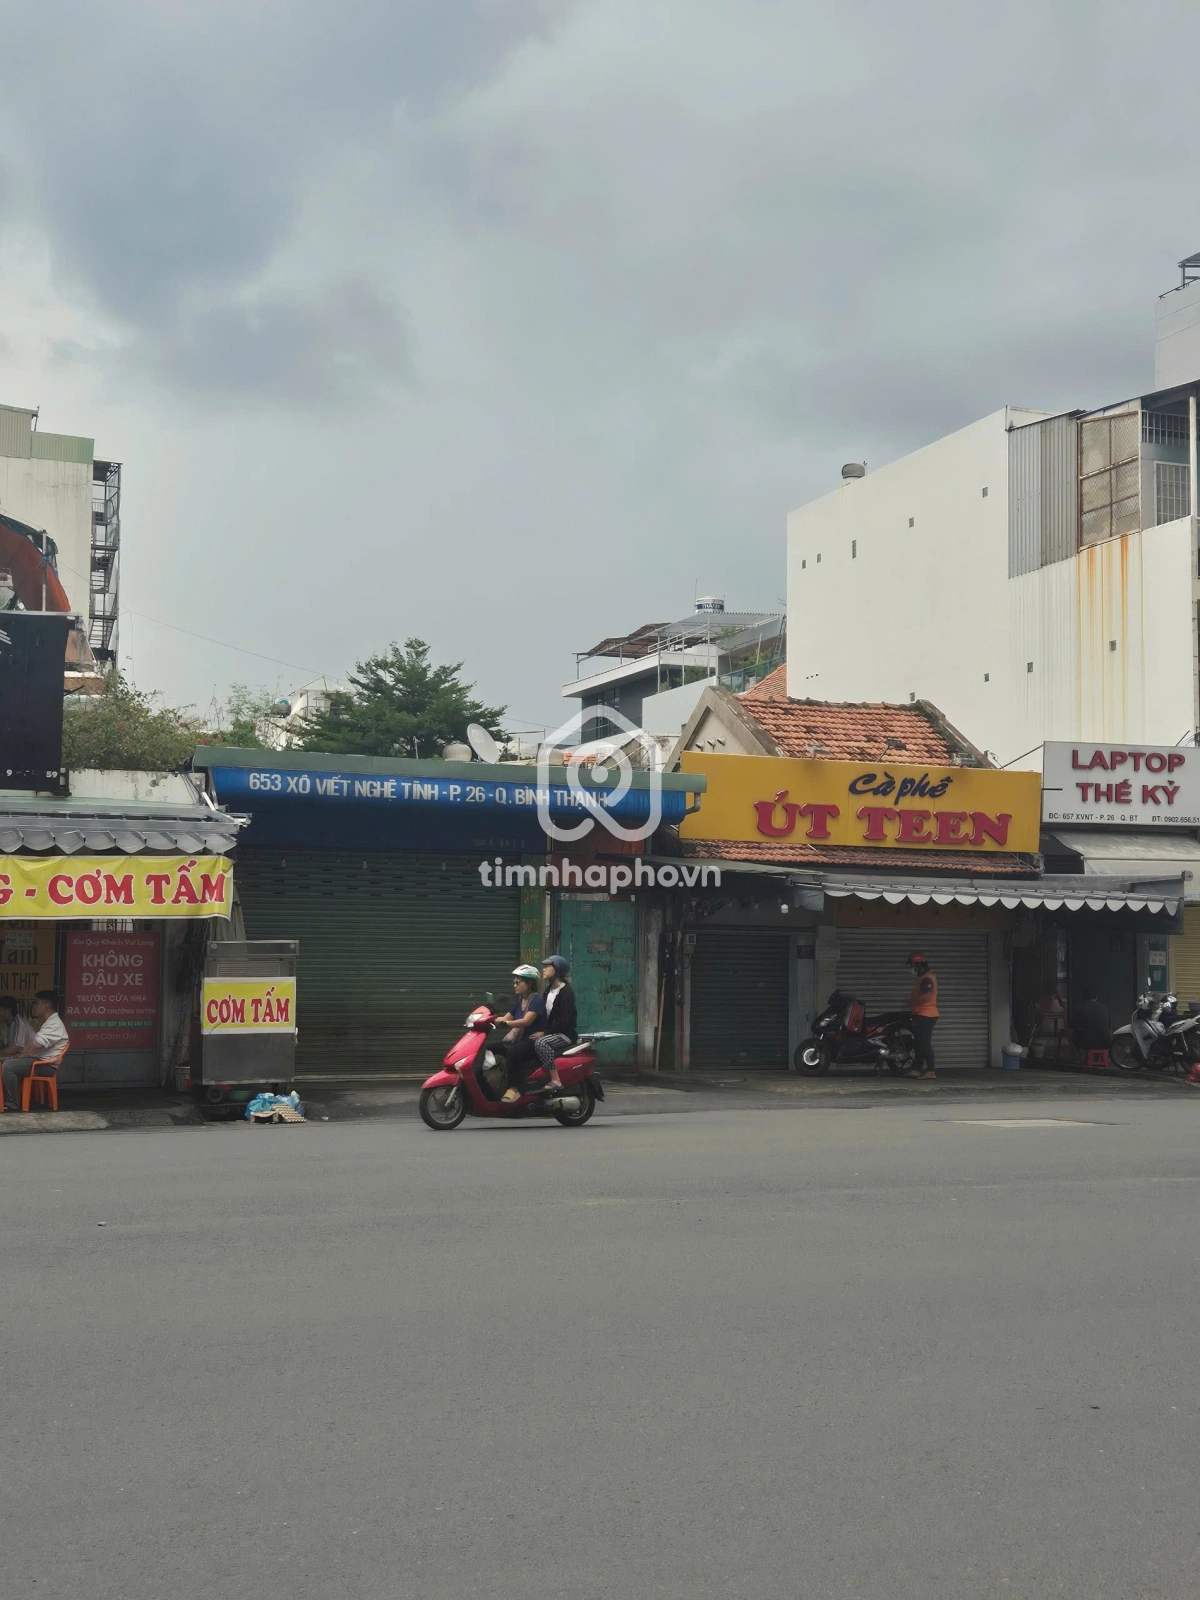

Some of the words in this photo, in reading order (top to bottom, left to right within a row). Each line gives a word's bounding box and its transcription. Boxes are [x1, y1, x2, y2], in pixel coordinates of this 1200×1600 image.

[1072, 750, 1186, 773] LAPTOP
[249, 773, 282, 791] 653
[286, 774, 311, 794] XÔ
[316, 775, 351, 796] VIẾT
[355, 779, 397, 801] NGHỆ
[401, 780, 439, 801] TĨNH
[449, 784, 460, 801] P.
[466, 786, 486, 803] 26
[495, 787, 512, 804] Q.
[515, 785, 550, 806] BÌNH
[554, 789, 608, 810] THẠNH
[849, 771, 896, 796] Cà
[893, 773, 953, 805] phê
[857, 805, 1013, 846] TEEN
[48, 868, 136, 905] CƠM
[145, 859, 226, 904] TẤM
[82, 949, 144, 967] KHÔNG
[81, 968, 119, 989] ĐẬU
[123, 973, 144, 986] XE
[67, 1006, 80, 1014] RA
[83, 1003, 106, 1014] VÀO
[76, 993, 107, 1002] TRƯỚC
[109, 992, 129, 1002] CỬA
[206, 994, 246, 1024] CƠM
[250, 986, 290, 1023] TẤM
